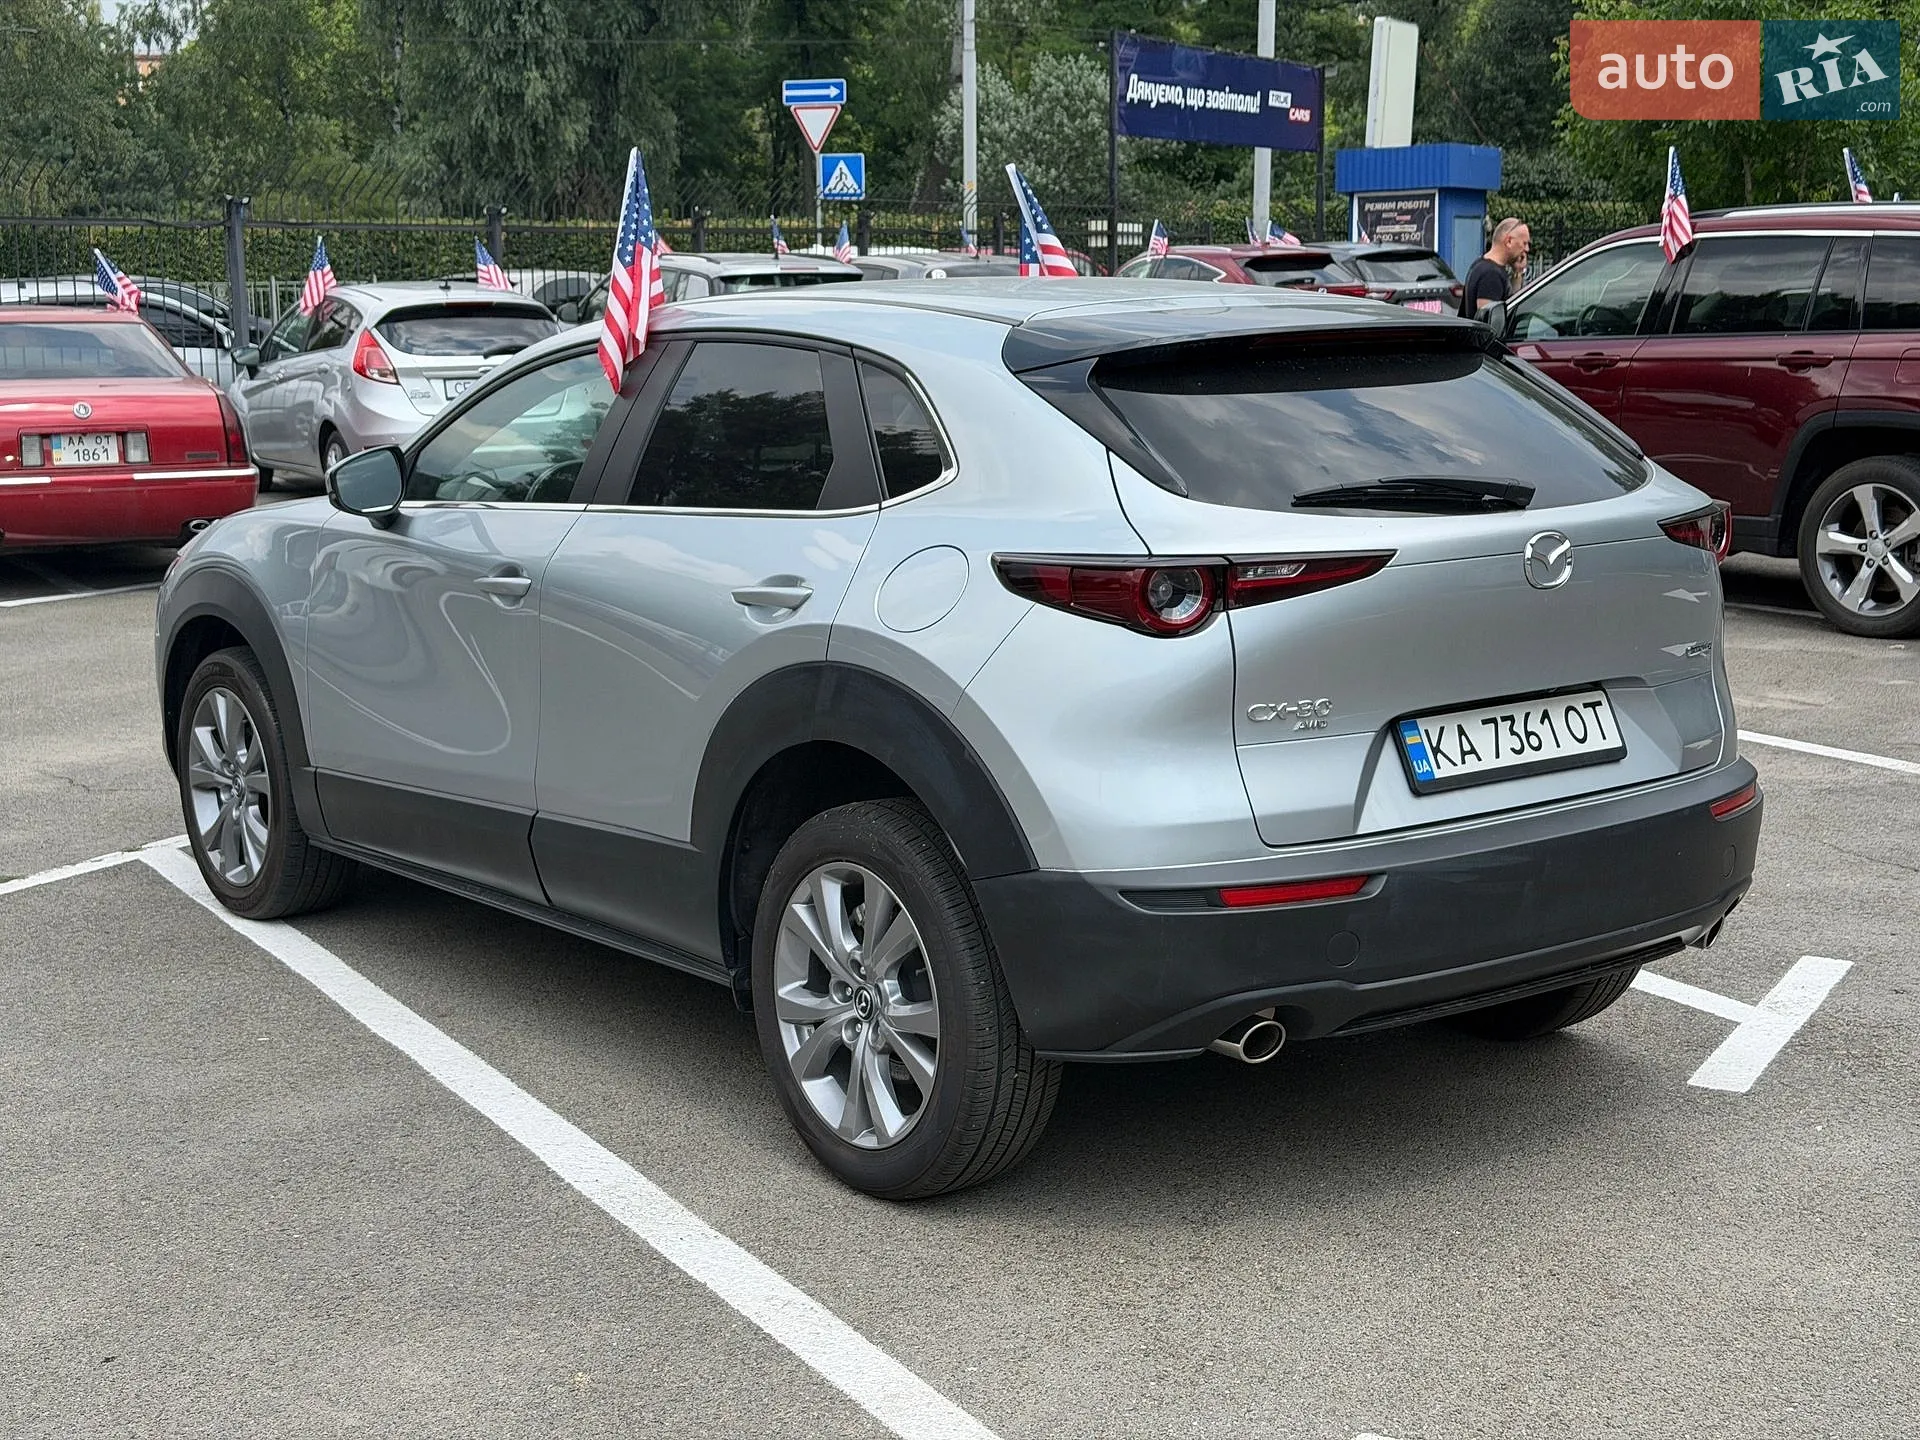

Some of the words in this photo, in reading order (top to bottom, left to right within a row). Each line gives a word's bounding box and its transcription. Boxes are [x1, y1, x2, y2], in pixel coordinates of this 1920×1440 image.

[1126, 73, 1185, 109] Дякуємо,
[1186, 87, 1205, 111] що
[1205, 85, 1261, 114] завітали!
[1289, 107, 1311, 121] CARS
[1364, 202, 1396, 211] РЕЖИМ
[1397, 200, 1430, 210] РОБОТИ
[67, 435, 85, 447] AA
[95, 434, 112, 446] OT
[73, 448, 110, 462] 1861
[1247, 698, 1333, 722] CX-30
[1293, 719, 1328, 732] AWD
[1424, 724, 1482, 770] KA
[1481, 708, 1561, 759] 7361
[1564, 700, 1607, 744] OT
[1413, 759, 1432, 773] UA
